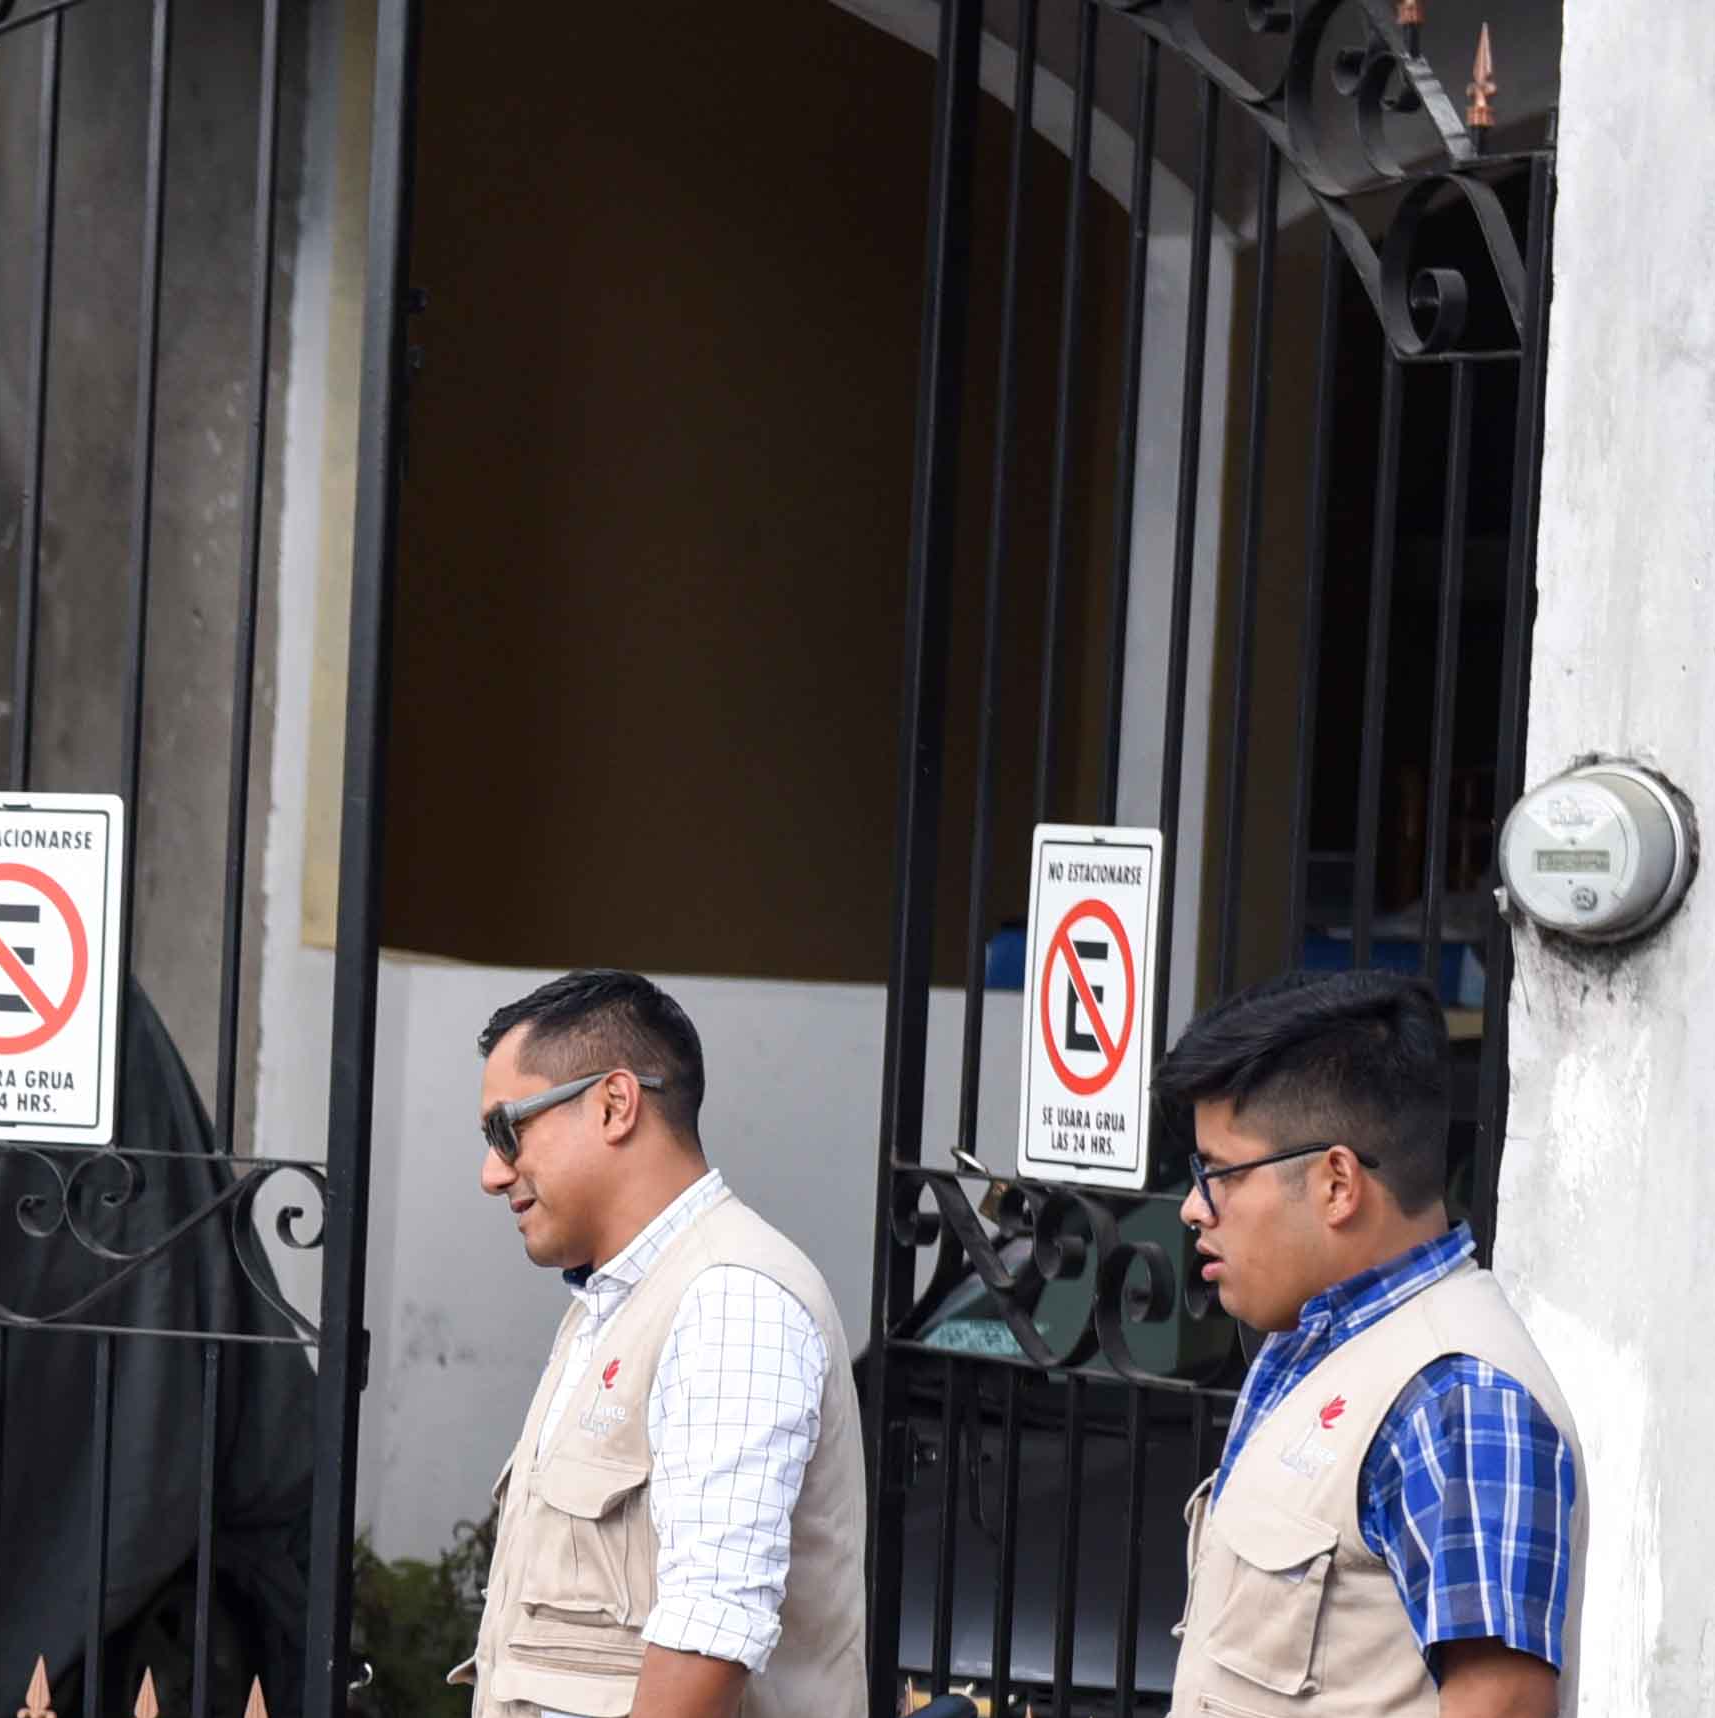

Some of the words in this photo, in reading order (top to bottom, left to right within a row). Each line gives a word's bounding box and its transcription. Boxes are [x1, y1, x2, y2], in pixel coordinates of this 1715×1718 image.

[1048, 861, 1064, 881] NO
[1067, 863, 1142, 886] ESTACIONARSE
[25, 1070, 74, 1090] GRUA
[17, 1093, 57, 1113] HRS.
[1042, 1105, 1054, 1126] SE
[1057, 1107, 1091, 1129] USARA
[1095, 1110, 1125, 1132] GRUA
[1051, 1131, 1069, 1151] LAS
[1073, 1133, 1087, 1153] 24
[1090, 1134, 1116, 1156] HRS.
